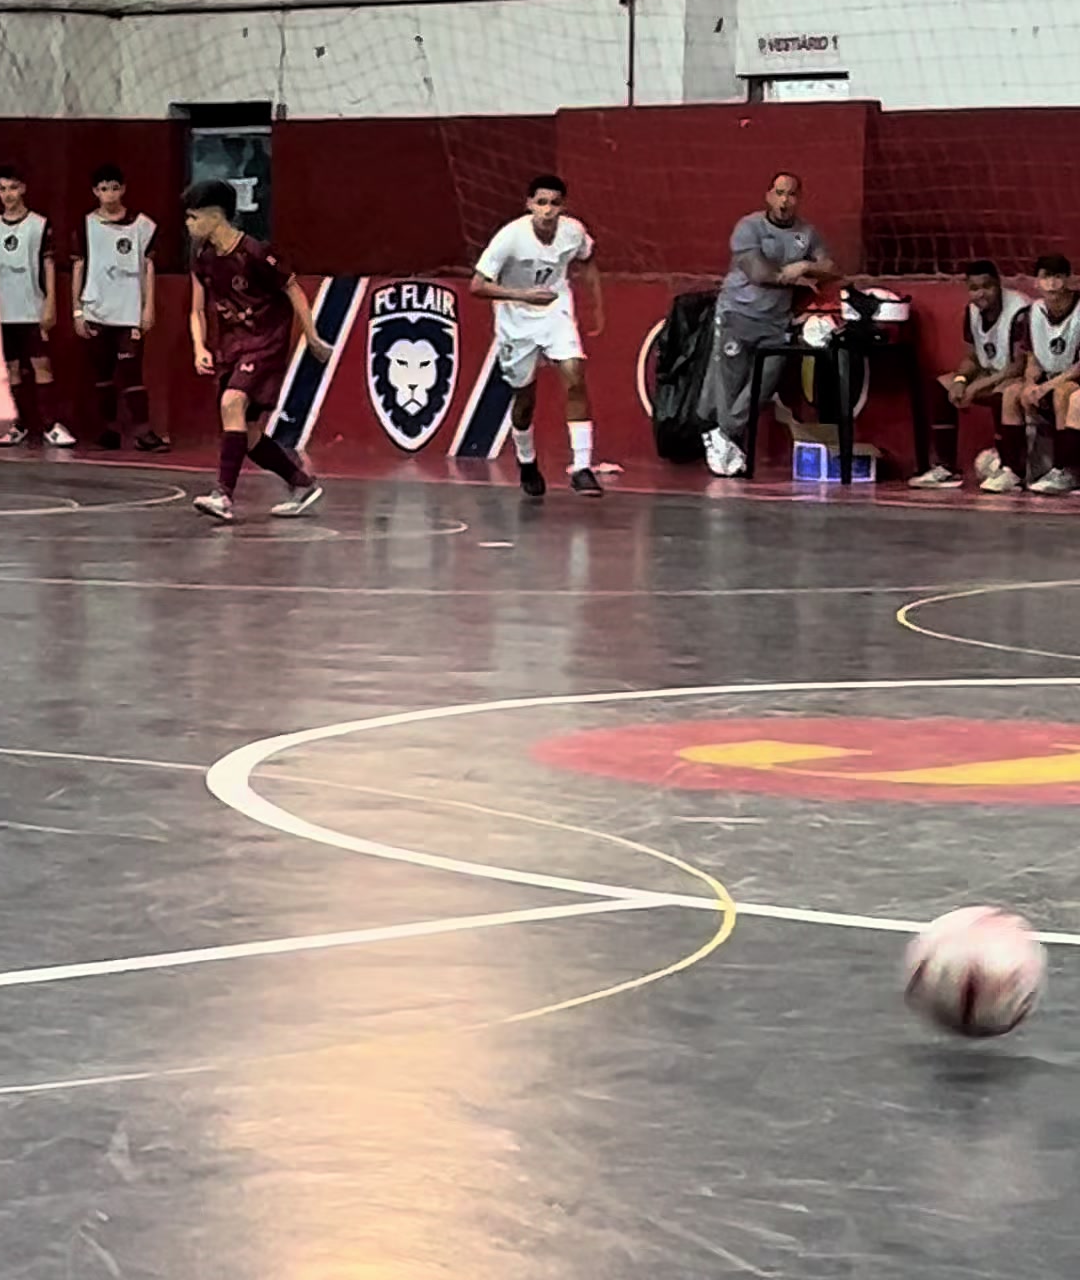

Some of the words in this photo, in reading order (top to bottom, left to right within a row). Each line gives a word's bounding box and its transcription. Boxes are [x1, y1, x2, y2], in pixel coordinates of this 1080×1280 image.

[535, 267, 553, 285] 17
[375, 286, 397, 315] FC
[401, 284, 456, 319] FLAIR
